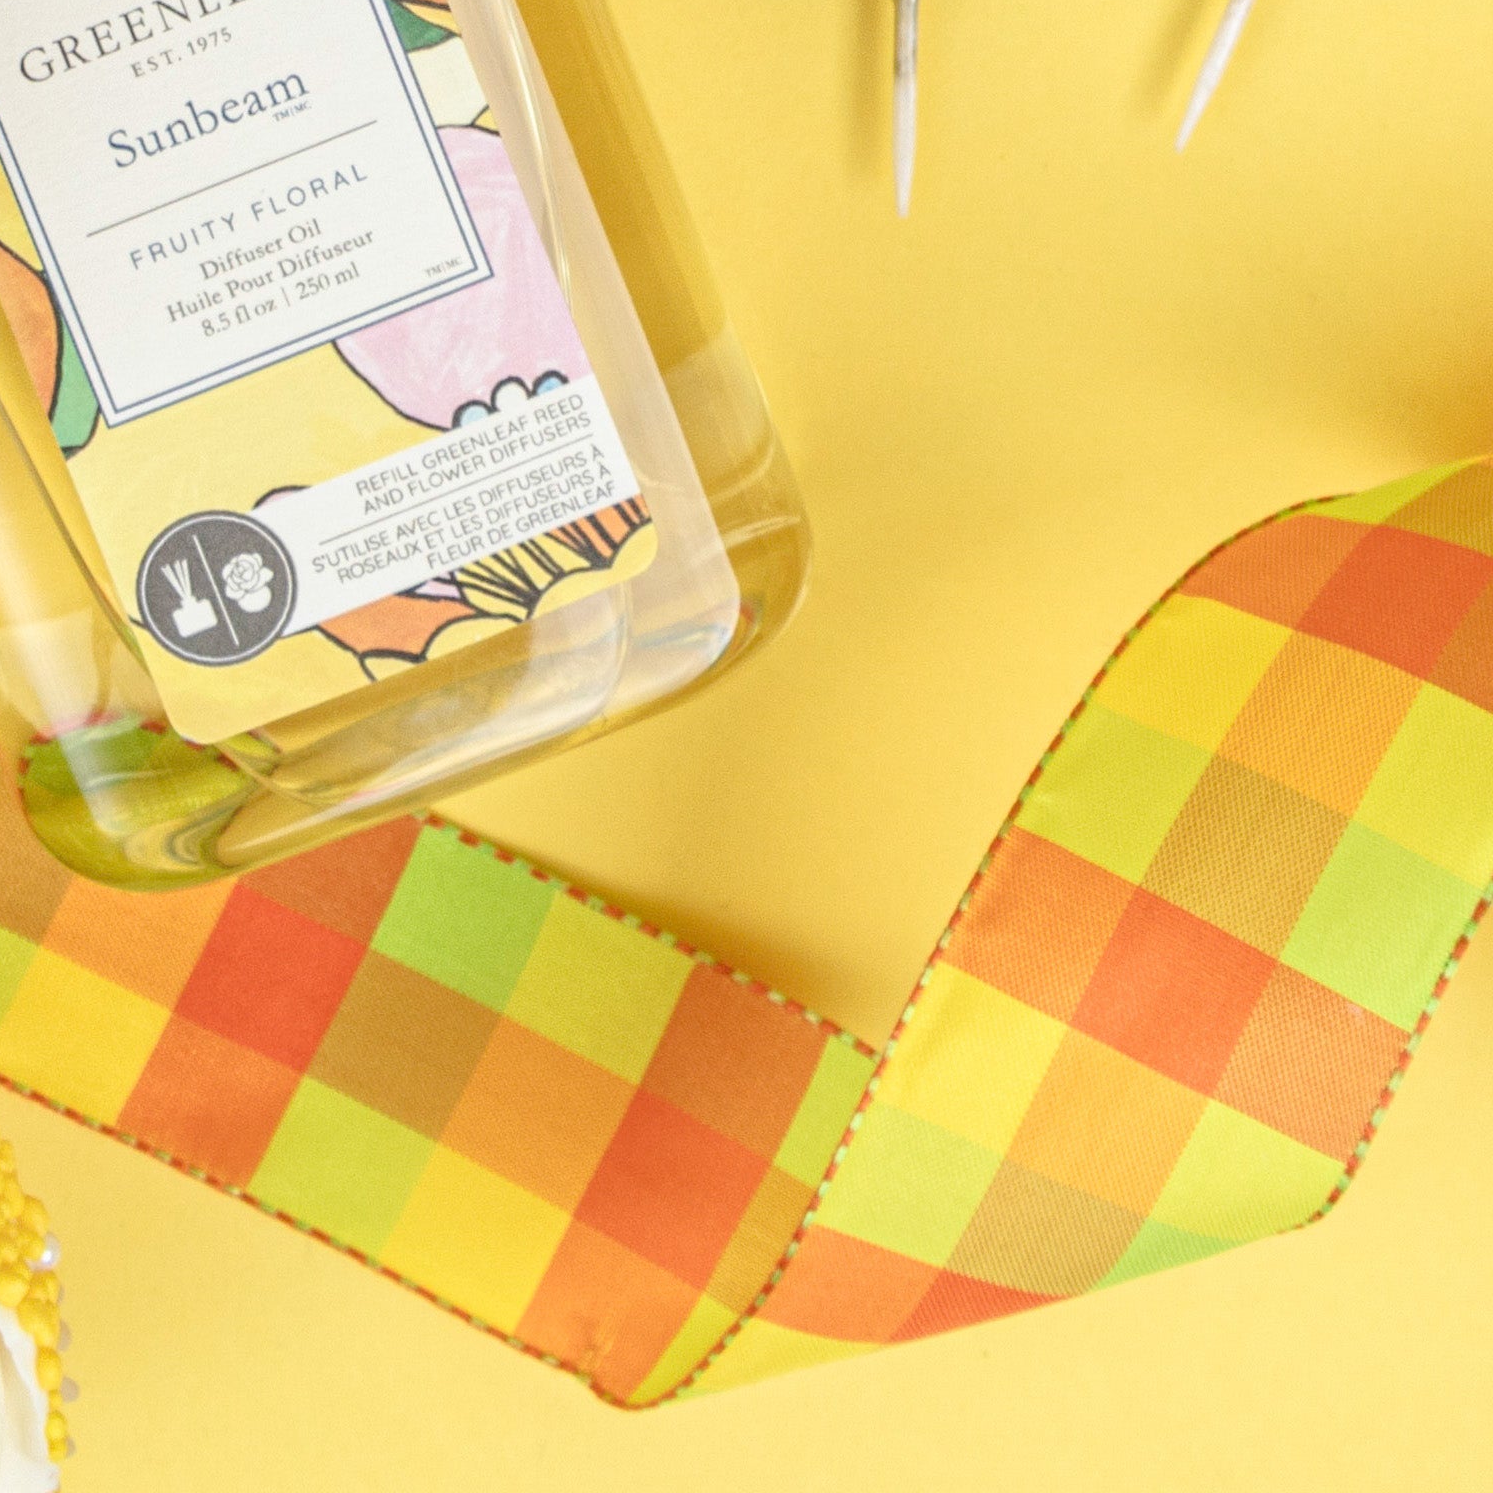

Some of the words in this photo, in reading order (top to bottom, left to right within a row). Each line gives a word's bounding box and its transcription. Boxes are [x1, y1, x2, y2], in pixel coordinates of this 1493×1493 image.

[129, 48, 182, 78] EST.
[185, 26, 232, 56] 1975
[106, 73, 309, 168] Sunbeam
[128, 211, 235, 270] FRUITY
[249, 163, 368, 222] FLORAL
[198, 237, 283, 280] Diffuser
[286, 217, 322, 244] Oil
[165, 290, 223, 323] Huile
[223, 269, 273, 299] Pour
[276, 230, 373, 278] Diffuseur
[201, 311, 232, 337] 8.5
[234, 303, 252, 325] fl
[253, 297, 278, 316] oz
[294, 272, 331, 301] 250
[333, 260, 360, 285] ml
[354, 462, 419, 496] REFILL
[420, 414, 528, 470] GREENLEAF
[532, 393, 584, 424] REED
[363, 487, 404, 515] AND
[405, 453, 486, 497] FLOWER
[487, 410, 591, 465] DIFFUSERS
[310, 529, 391, 574] S'UTILISE
[395, 510, 441, 541] AVEC
[442, 495, 477, 521] LES
[476, 450, 588, 507] DIFFUSEURS
[590, 443, 605, 461] À
[335, 539, 422, 584] ROSEAUX
[422, 527, 445, 550] ET
[449, 513, 484, 539] LES
[483, 467, 595, 525] DIFFUSEURS
[597, 460, 611, 480] À
[425, 534, 485, 570] FLEUR
[485, 522, 513, 546] DE
[514, 479, 614, 533] GREENLEAF
